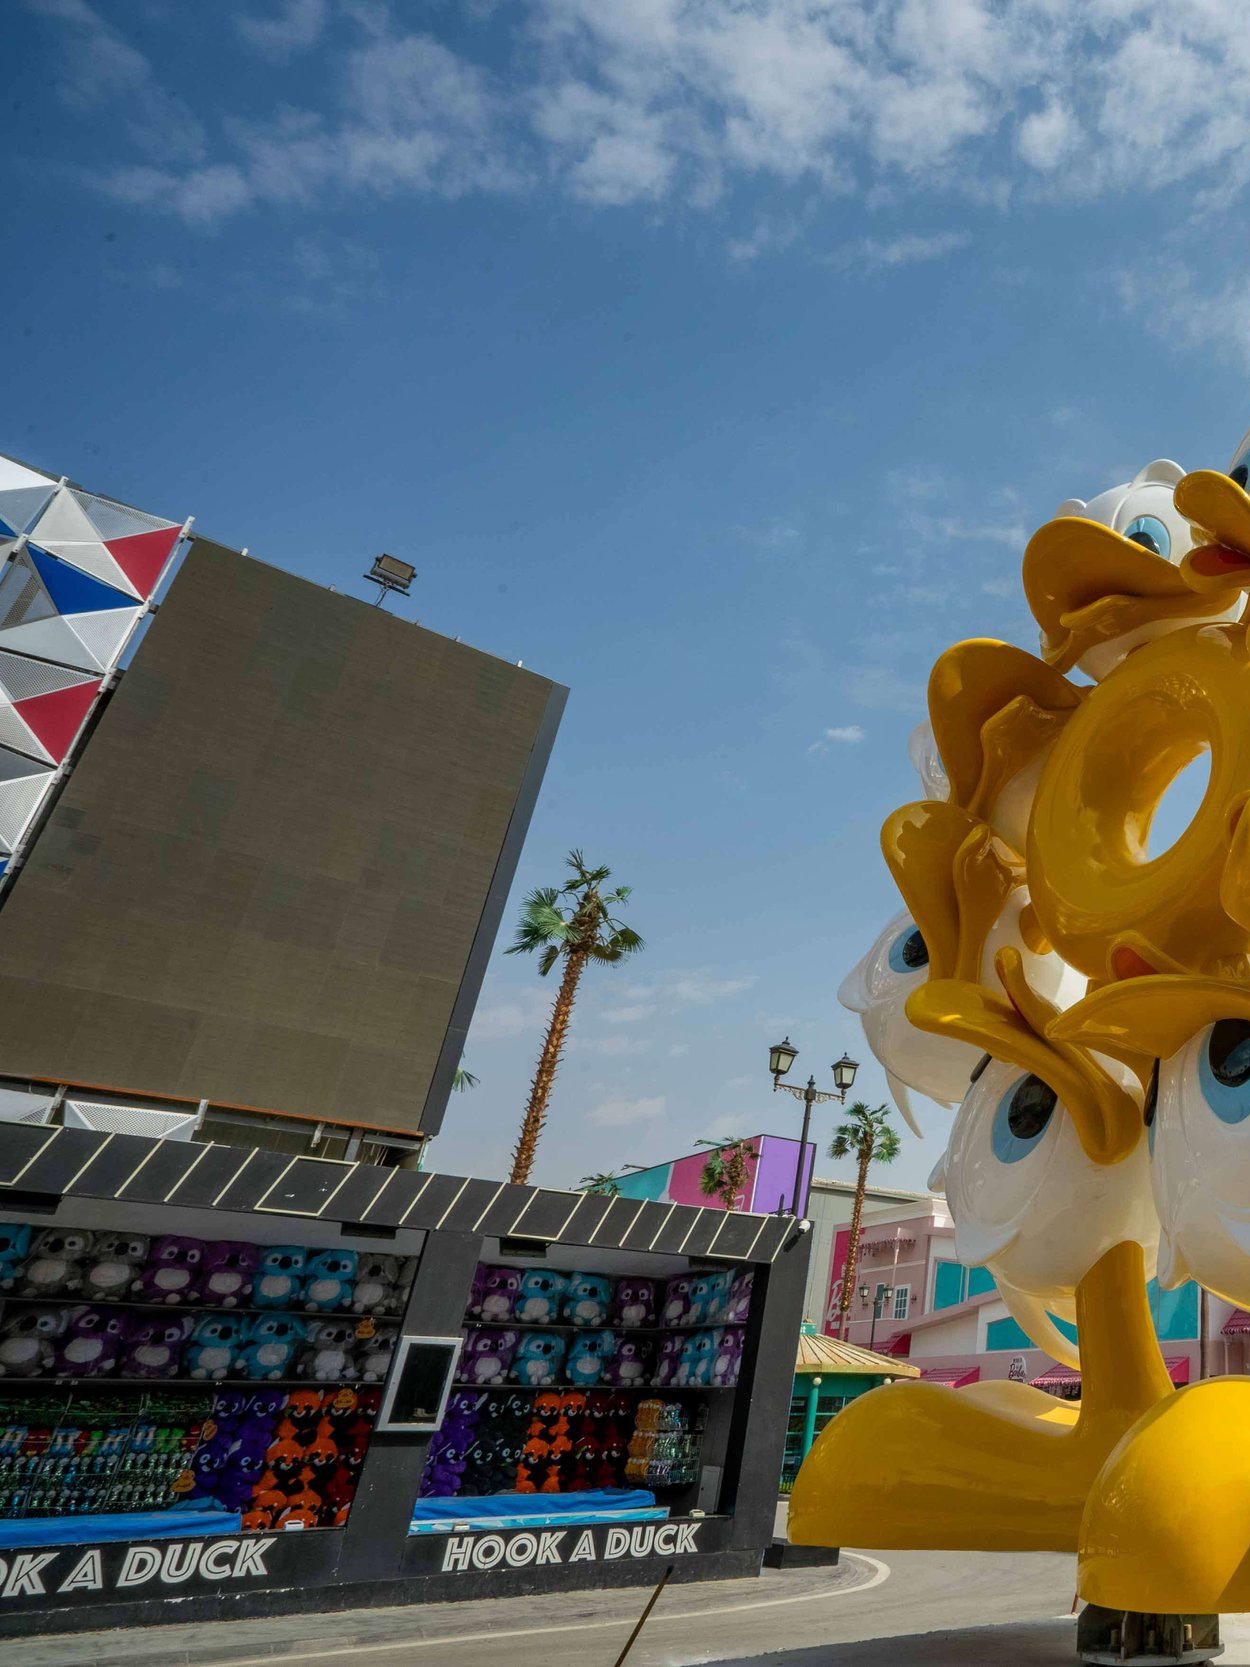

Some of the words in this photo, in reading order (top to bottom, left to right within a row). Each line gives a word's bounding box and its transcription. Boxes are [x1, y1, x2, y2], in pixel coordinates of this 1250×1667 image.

[0, 1552, 60, 1598] K
[56, 1549, 103, 1593] A
[116, 1537, 278, 1588] DUCK
[441, 1531, 567, 1572] HOOK
[568, 1529, 596, 1562] A
[604, 1523, 702, 1560] DUCK
